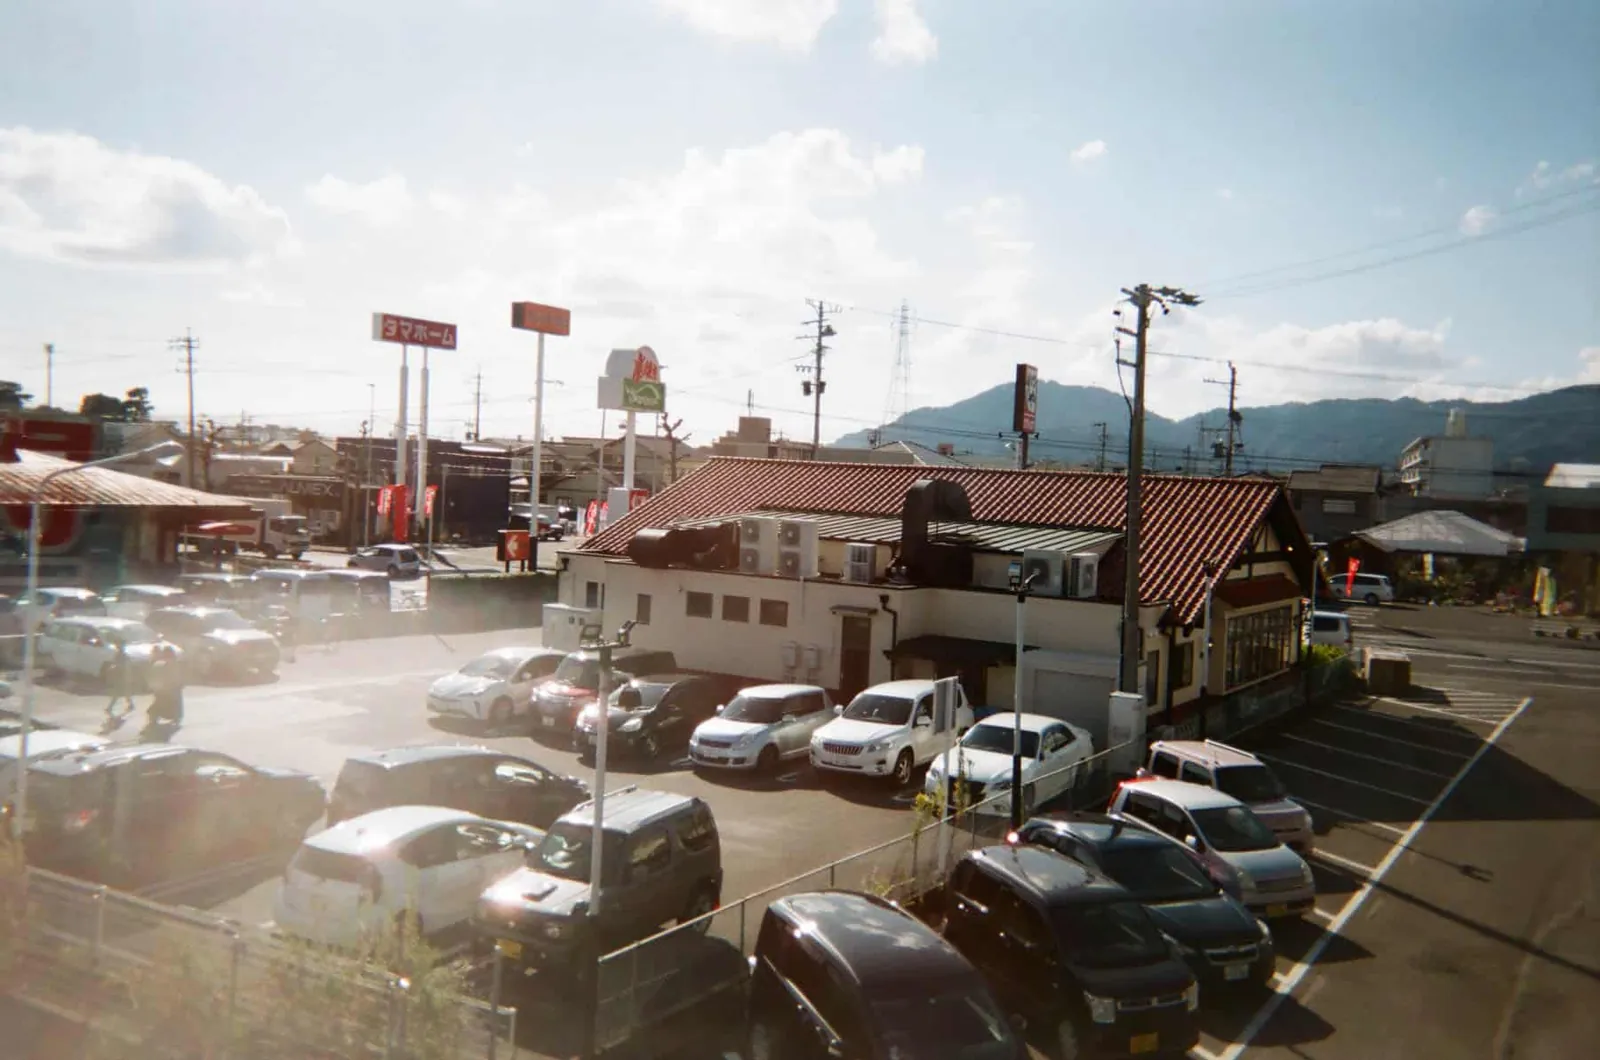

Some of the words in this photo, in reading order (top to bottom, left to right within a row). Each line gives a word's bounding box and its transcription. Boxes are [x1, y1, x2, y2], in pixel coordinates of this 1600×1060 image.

[383, 318, 454, 346] タマホーム
